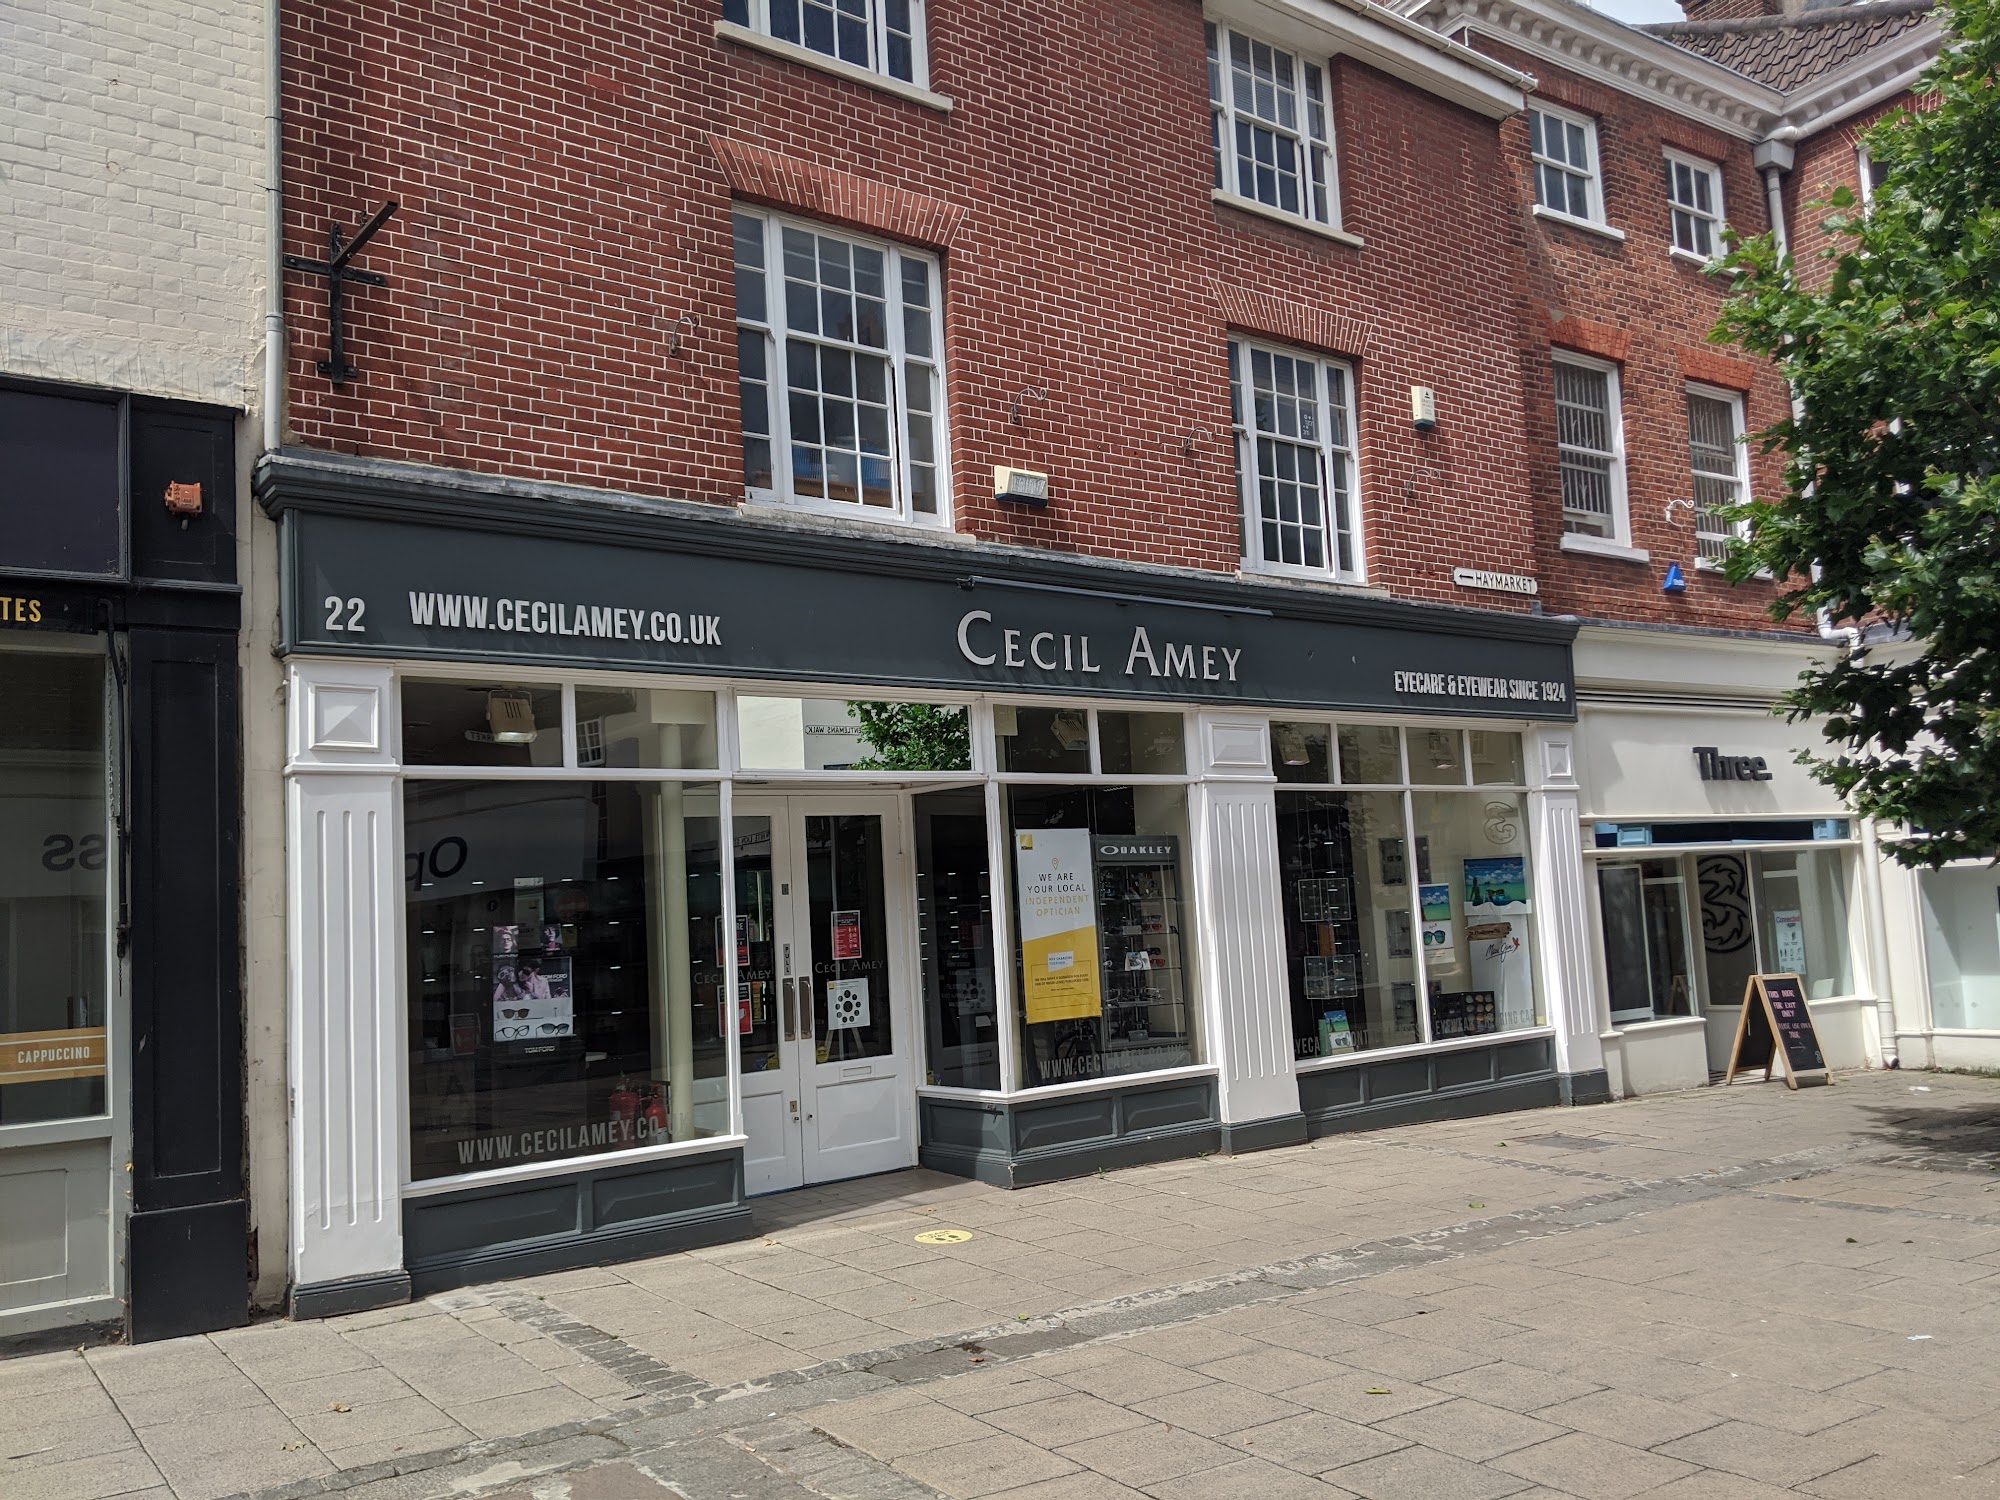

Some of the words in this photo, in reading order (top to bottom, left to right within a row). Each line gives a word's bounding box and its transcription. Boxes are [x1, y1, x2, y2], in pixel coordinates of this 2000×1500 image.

[1475, 571, 1533, 592] HAYMARKET
[324, 596, 366, 632] 22
[408, 591, 722, 646] WWW.CECILAMEY.CO.UK
[1394, 670, 1446, 695] EYECARE
[1447, 674, 1457, 696] &
[1457, 675, 1508, 699] EYEWEAR
[1508, 679, 1539, 701] SINCE
[1540, 681, 1567, 702] 1924
[1120, 846, 1172, 855] OAKLEY
[1038, 873, 1052, 882] WE
[1057, 872, 1074, 881] ARE
[1027, 885, 1053, 894] YOUR
[1057, 883, 1086, 893] LOCAL
[1025, 894, 1089, 906] INDEPENDENT
[1036, 906, 1080, 917] OPTICIAN
[1784, 1001, 1796, 1009] EXIT
[1781, 1009, 1795, 1018] ONLY
[17, 1046, 90, 1064] CAPPUCCINO
